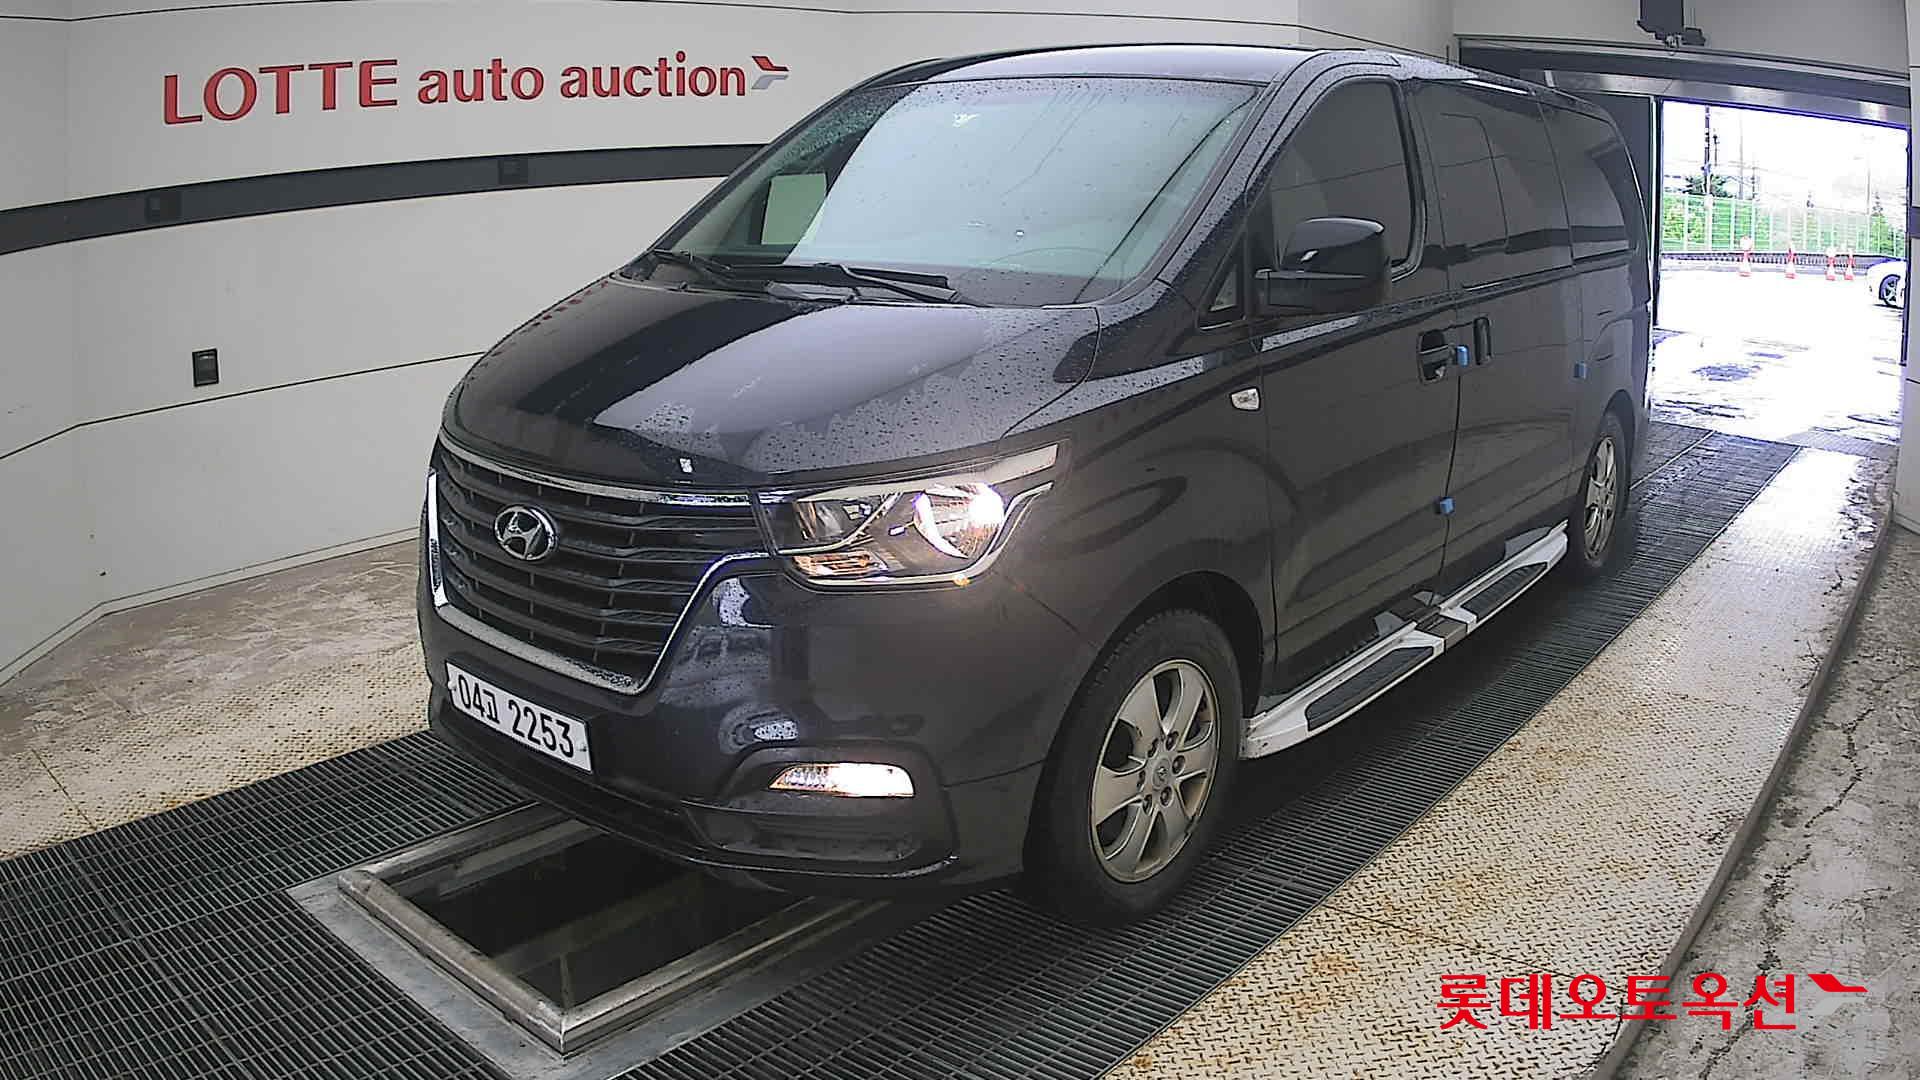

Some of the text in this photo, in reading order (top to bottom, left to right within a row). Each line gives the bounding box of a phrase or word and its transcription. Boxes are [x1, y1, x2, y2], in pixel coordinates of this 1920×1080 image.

[164, 51, 746, 125] LOTTE auto auction
[508, 699, 574, 758] 2253
